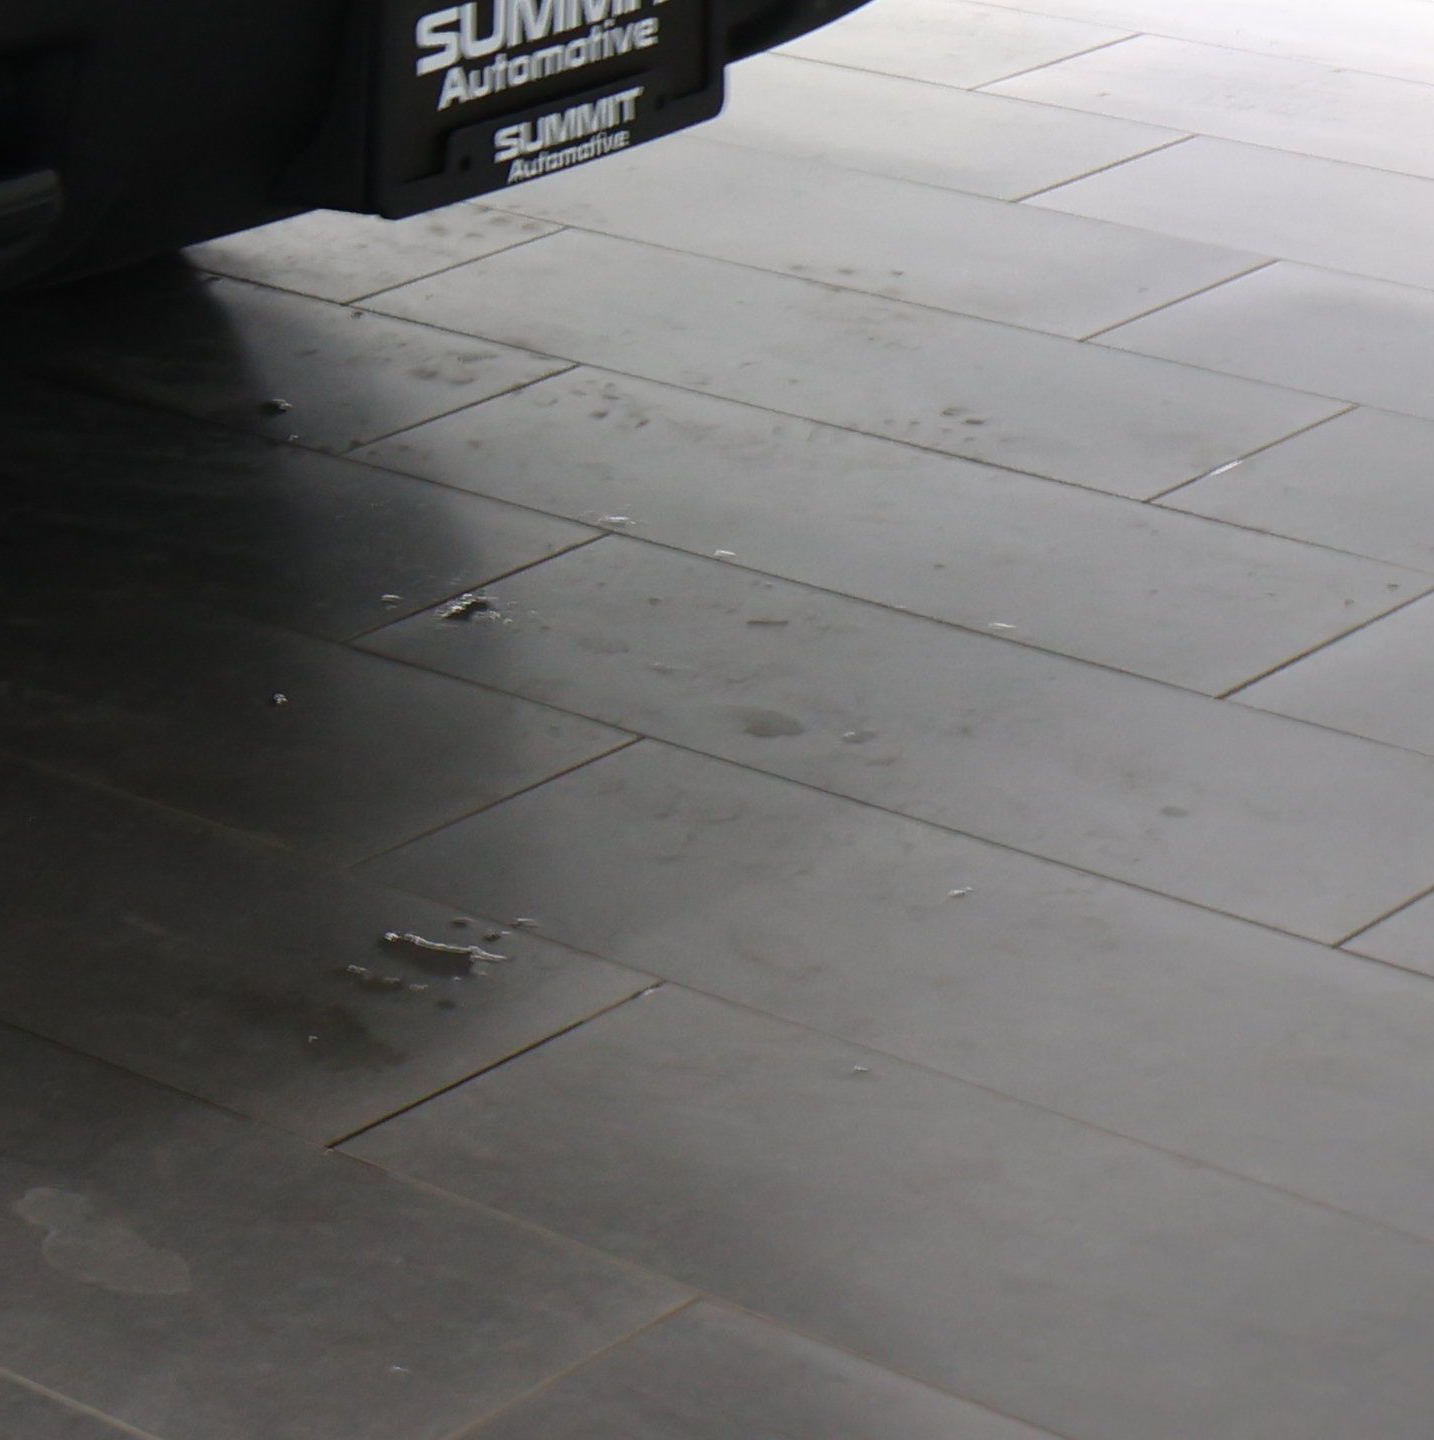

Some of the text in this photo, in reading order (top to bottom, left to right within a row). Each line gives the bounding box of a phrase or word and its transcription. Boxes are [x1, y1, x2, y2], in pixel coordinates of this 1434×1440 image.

[437, 17, 659, 111] Automotive
[494, 86, 645, 163] SUMMIT
[507, 129, 631, 184] Automotive
